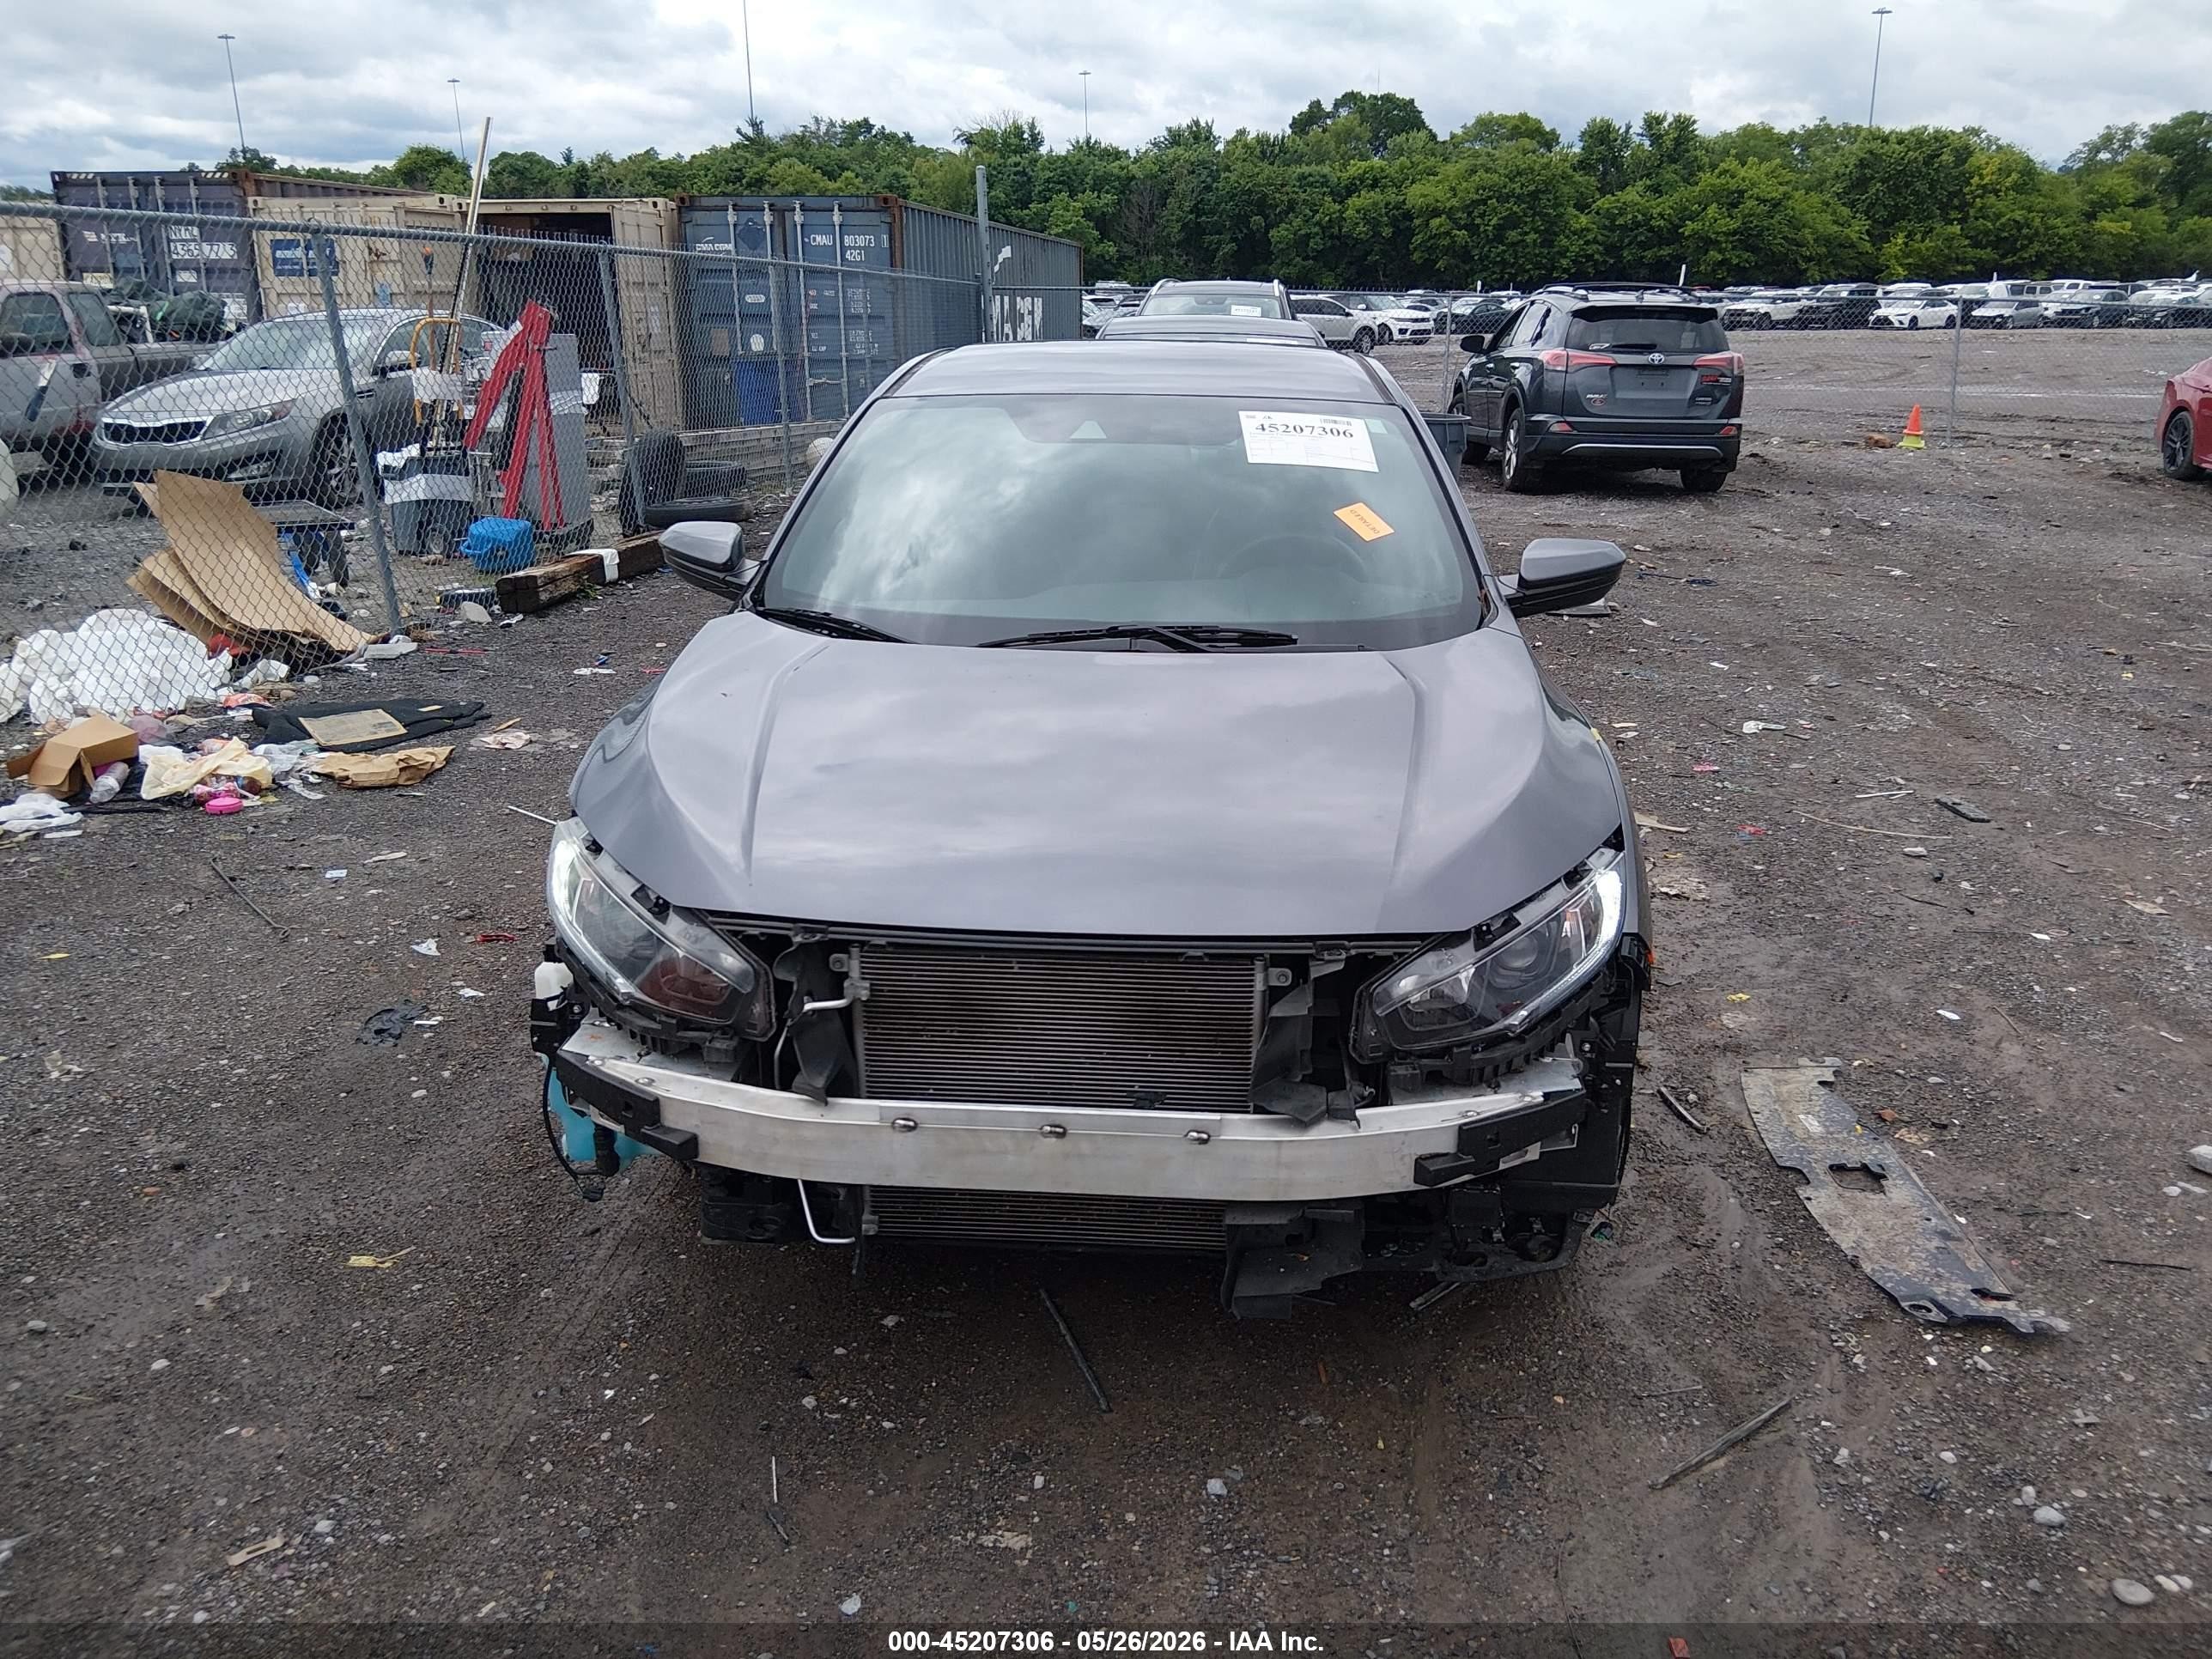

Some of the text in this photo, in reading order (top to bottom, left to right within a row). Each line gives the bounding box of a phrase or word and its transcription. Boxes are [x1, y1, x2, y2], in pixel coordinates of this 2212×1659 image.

[811, 234, 833, 246] CMAU
[844, 235, 874, 246] 803073
[846, 250, 865, 261] 42G1
[1017, 297, 1043, 341] CGM
[1255, 423, 1354, 439] 45207306
